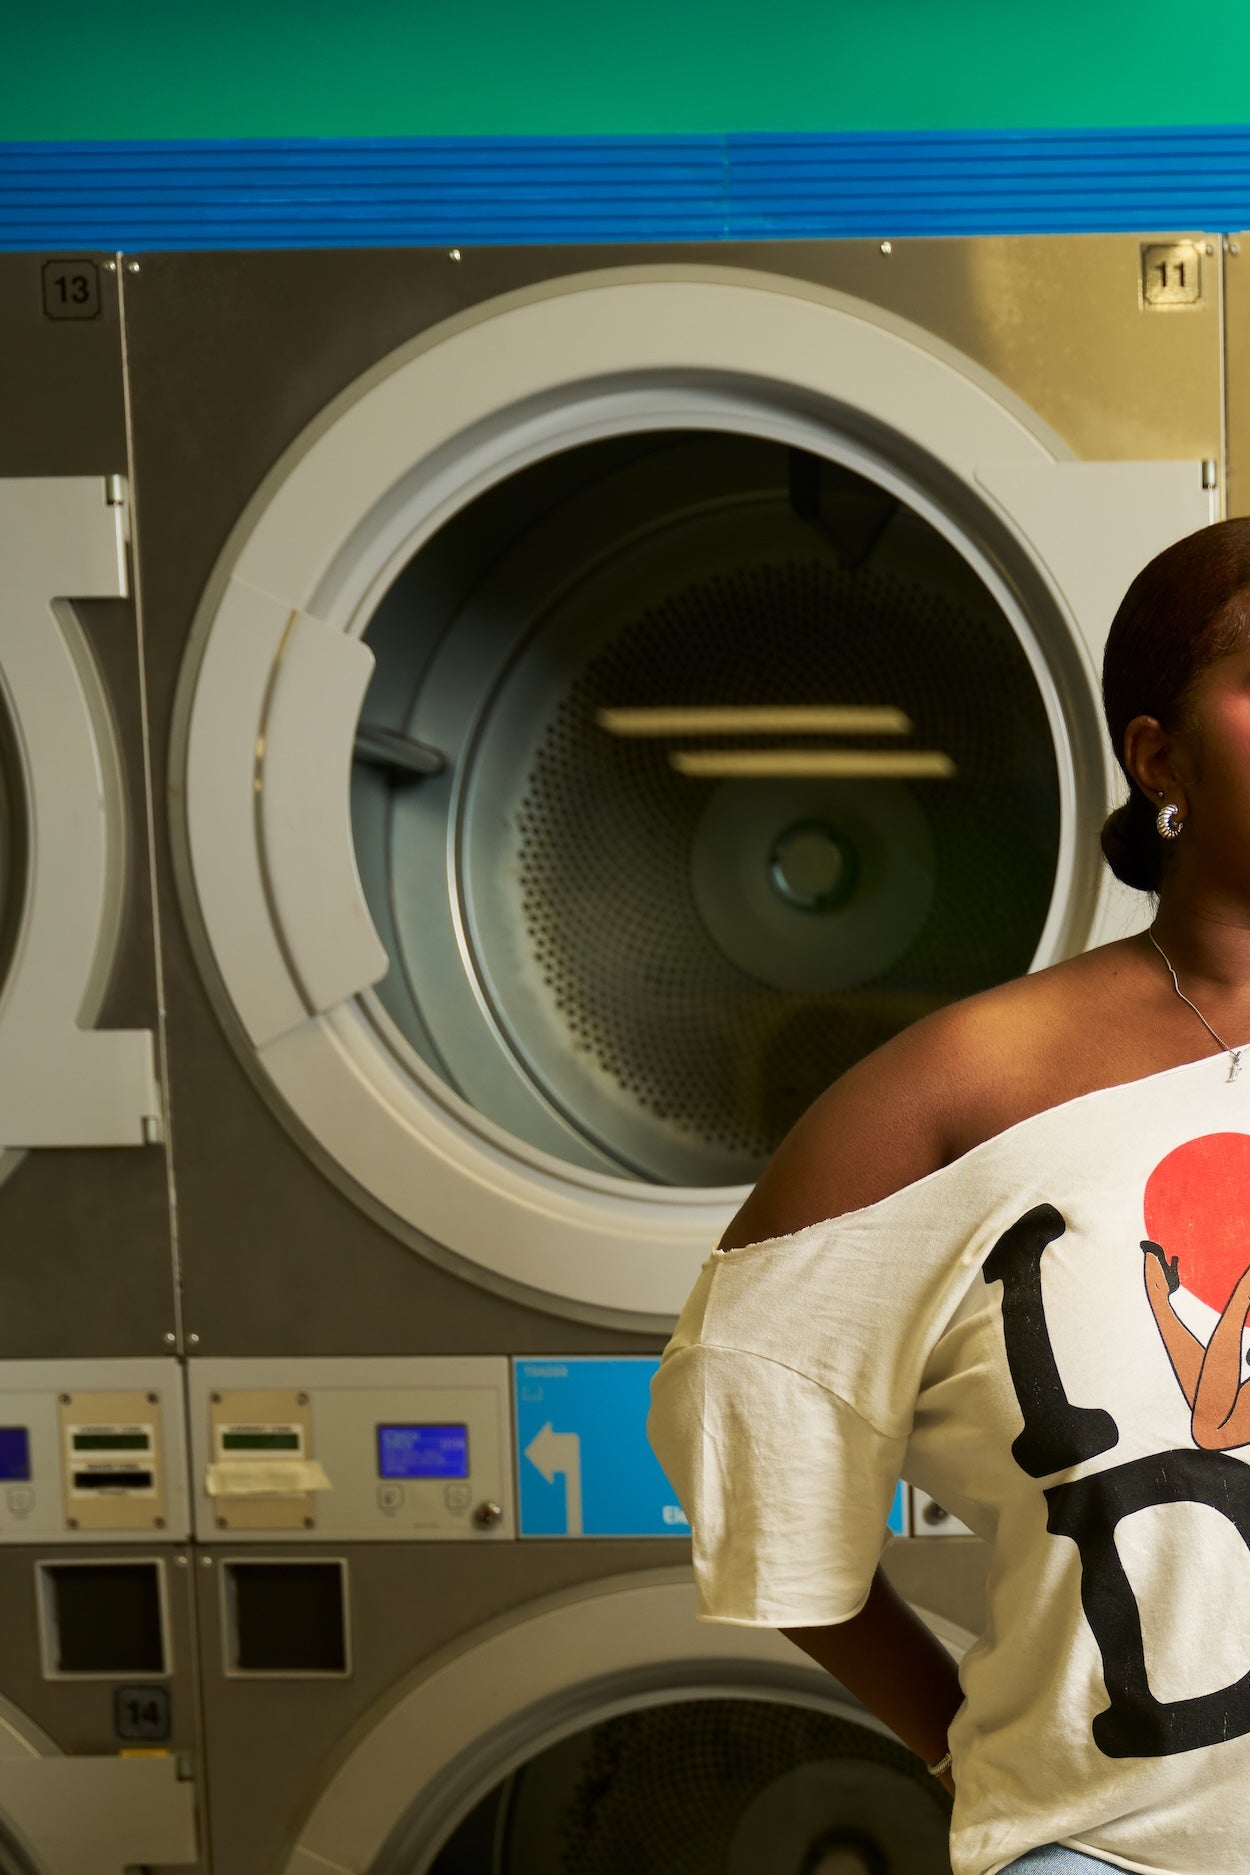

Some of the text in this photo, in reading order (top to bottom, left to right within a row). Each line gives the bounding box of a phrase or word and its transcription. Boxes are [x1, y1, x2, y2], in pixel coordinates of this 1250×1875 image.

[1154, 260, 1186, 288] 11
[54, 275, 90, 304] 13
[982, 1202, 1120, 1479] I
[126, 1700, 161, 1727] 14
